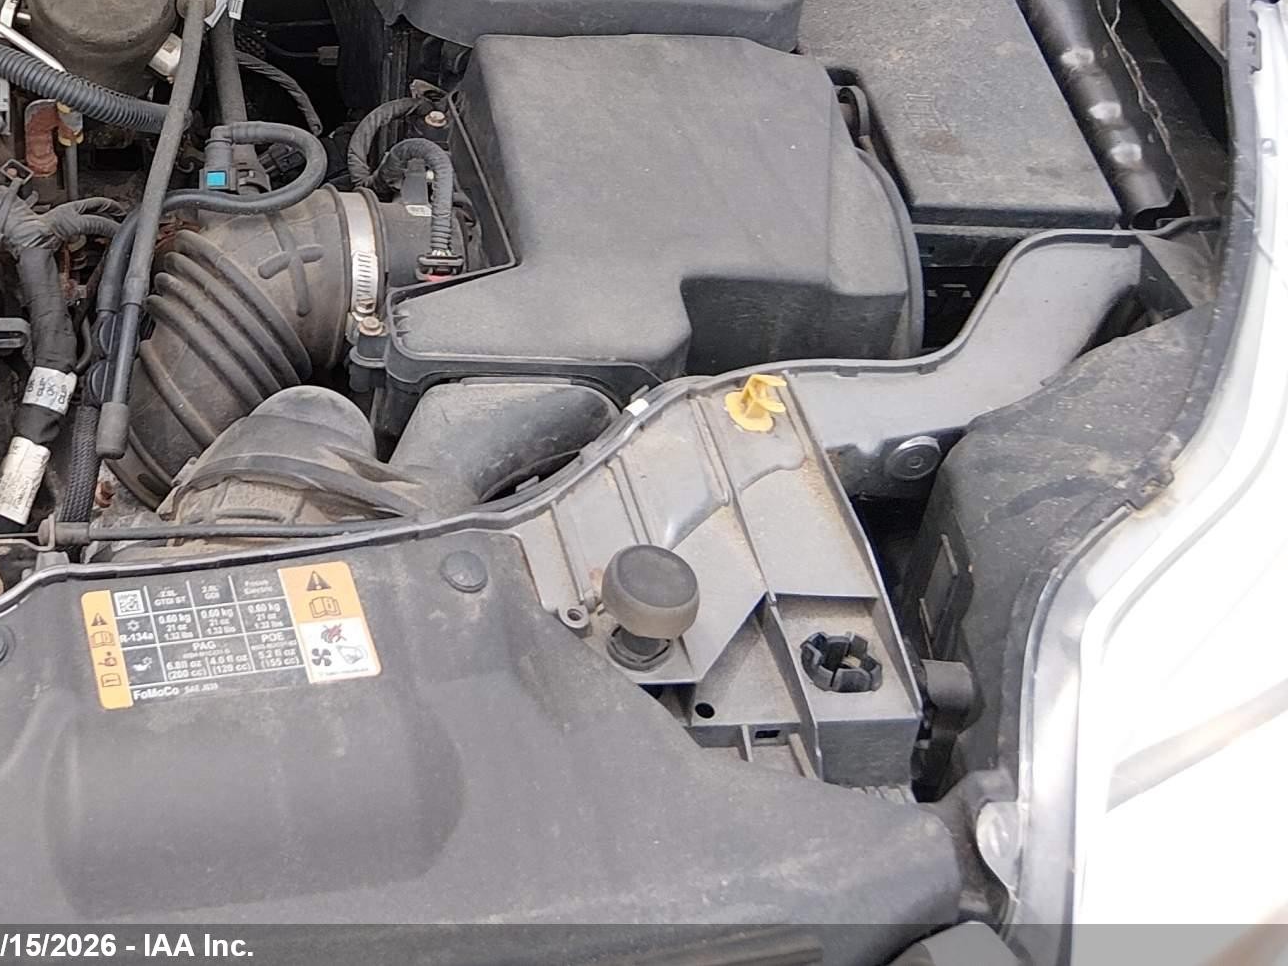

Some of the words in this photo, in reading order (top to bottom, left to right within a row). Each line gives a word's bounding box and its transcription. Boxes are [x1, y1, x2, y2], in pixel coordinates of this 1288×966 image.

[46, 382, 56, 396] OK
[200, 609, 220, 619] 0.60
[220, 607, 234, 618] kg
[247, 603, 267, 614] 0.60
[267, 602, 281, 613] kg
[158, 614, 178, 624] 0.60
[178, 613, 192, 624] kg
[208, 618, 218, 626] 21
[255, 613, 266, 621] 21
[267, 612, 277, 620] oz
[165, 624, 176, 632] 21
[119, 632, 155, 643] R-134a
[261, 632, 285, 643] POE
[192, 640, 217, 651] PAG
[235, 654, 248, 662] oz
[257, 649, 272, 659] 5.2
[283, 648, 297, 656] oz
[190, 660, 202, 668] oz
[235, 662, 251, 672] cc)
[260, 657, 282, 668] (155
[283, 656, 299, 665] cc)
[190, 667, 206, 677] cc)
[133, 686, 180, 701] FoMoCo
